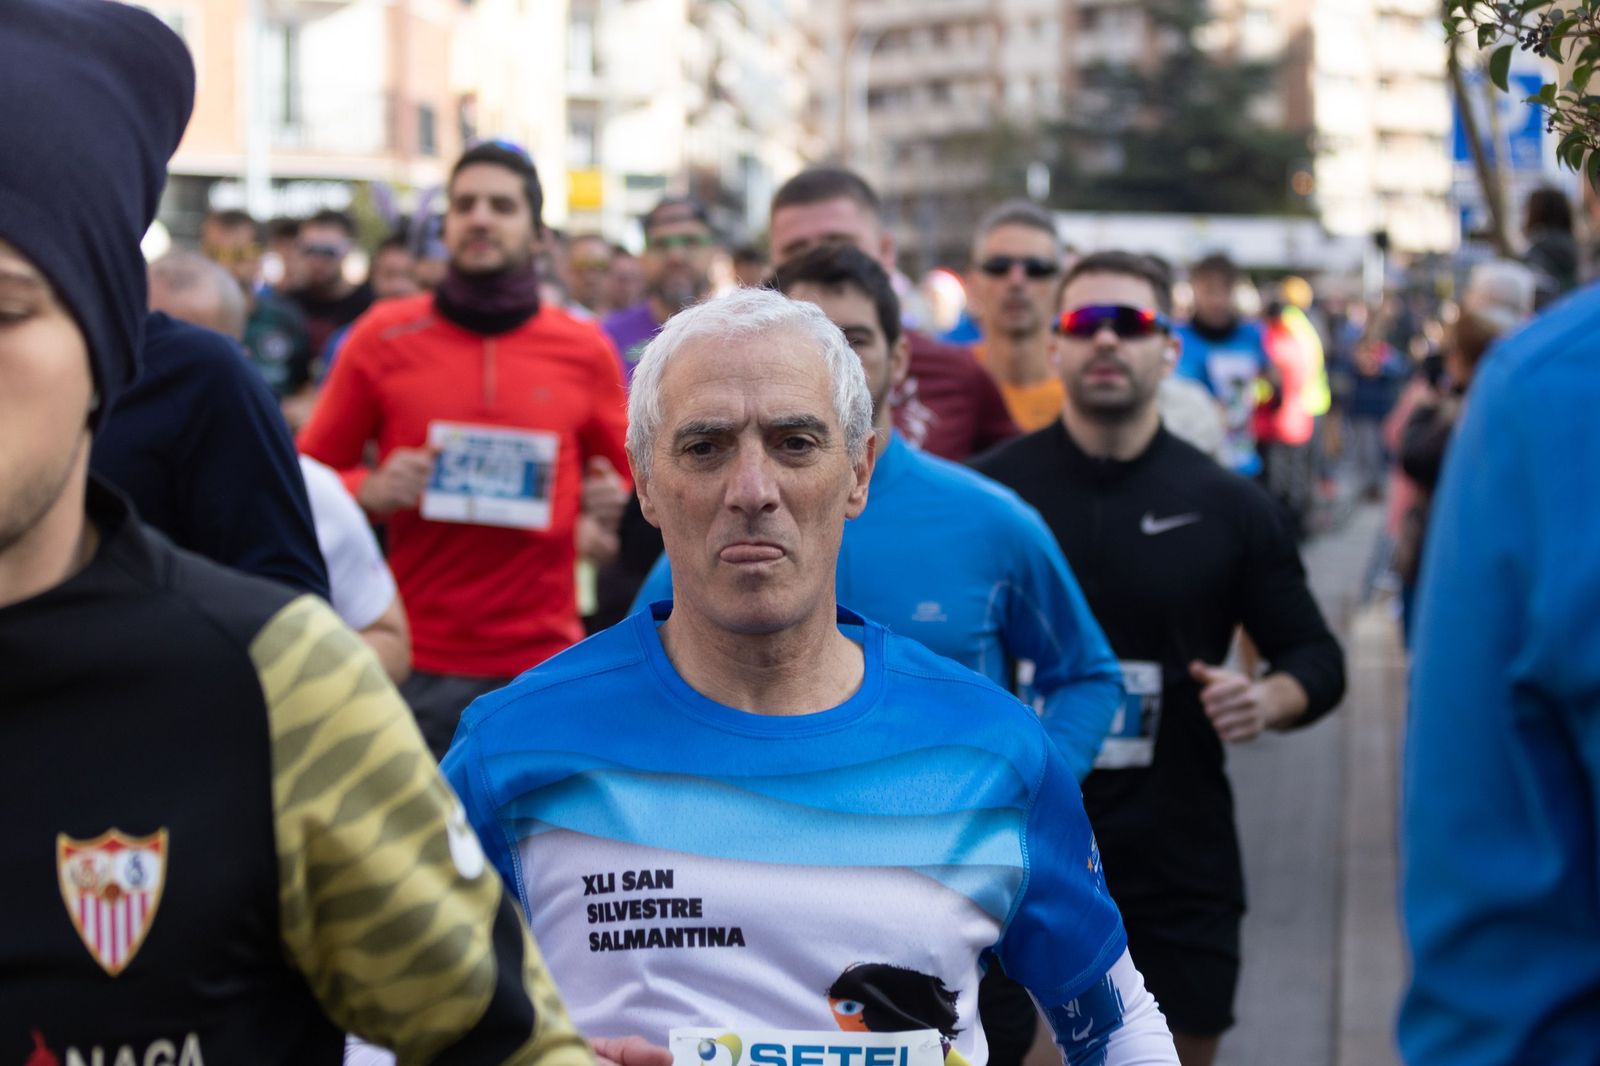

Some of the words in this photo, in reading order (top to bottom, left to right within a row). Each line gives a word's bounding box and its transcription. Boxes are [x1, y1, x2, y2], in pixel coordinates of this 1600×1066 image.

[582, 873, 615, 896] XLI
[622, 869, 674, 891] SAN
[587, 898, 703, 924] SILVESTRE
[589, 927, 746, 952] SALMANTINA
